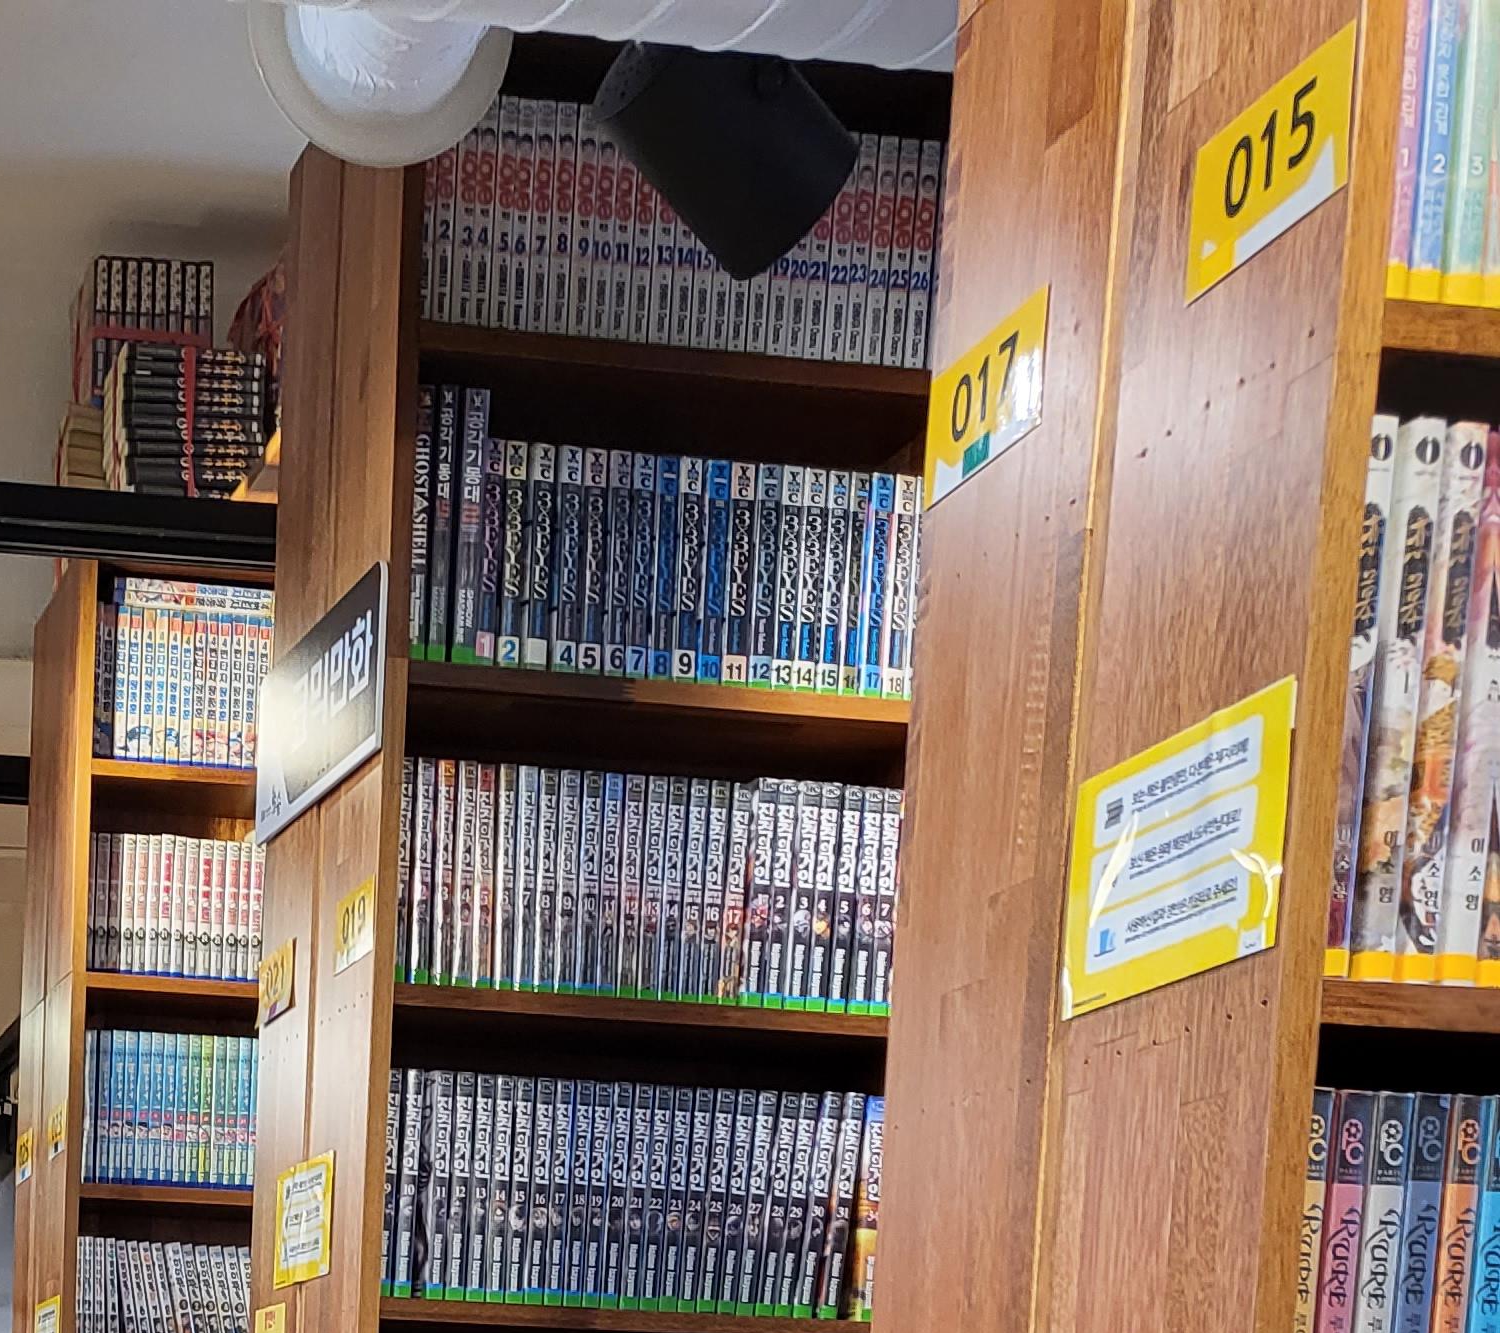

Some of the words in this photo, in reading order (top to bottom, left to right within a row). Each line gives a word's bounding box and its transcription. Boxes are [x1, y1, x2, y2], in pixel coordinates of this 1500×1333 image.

[1224, 77, 1317, 219] 015
[1400, 149, 1409, 166] 1
[1433, 154, 1446, 173] 2
[1471, 156, 1483, 174] 3
[515, 236, 526, 255] 6
[579, 238, 589, 257] 9
[831, 266, 848, 284] 22
[891, 270, 908, 288] 25
[912, 271, 929, 289] 26
[952, 331, 1021, 442] 017
[464, 411, 484, 503] 공각기동대
[503, 640, 515, 662] 2
[559, 644, 573, 665] 4
[582, 647, 597, 668] 5
[629, 649, 644, 669] 7
[678, 652, 692, 675] 9
[726, 663, 742, 680] 11
[795, 666, 812, 685] 14
[820, 669, 837, 685] 15
[776, 896, 785, 908] 2
[817, 899, 826, 912] 4
[839, 901, 849, 913] 5
[342, 896, 366, 944] 019
[266, 955, 284, 1001] 021
[435, 1187, 446, 1198] 11
[514, 1191, 525, 1202] 15
[649, 1198, 662, 1208] 22
[836, 1208, 849, 1219] 31
